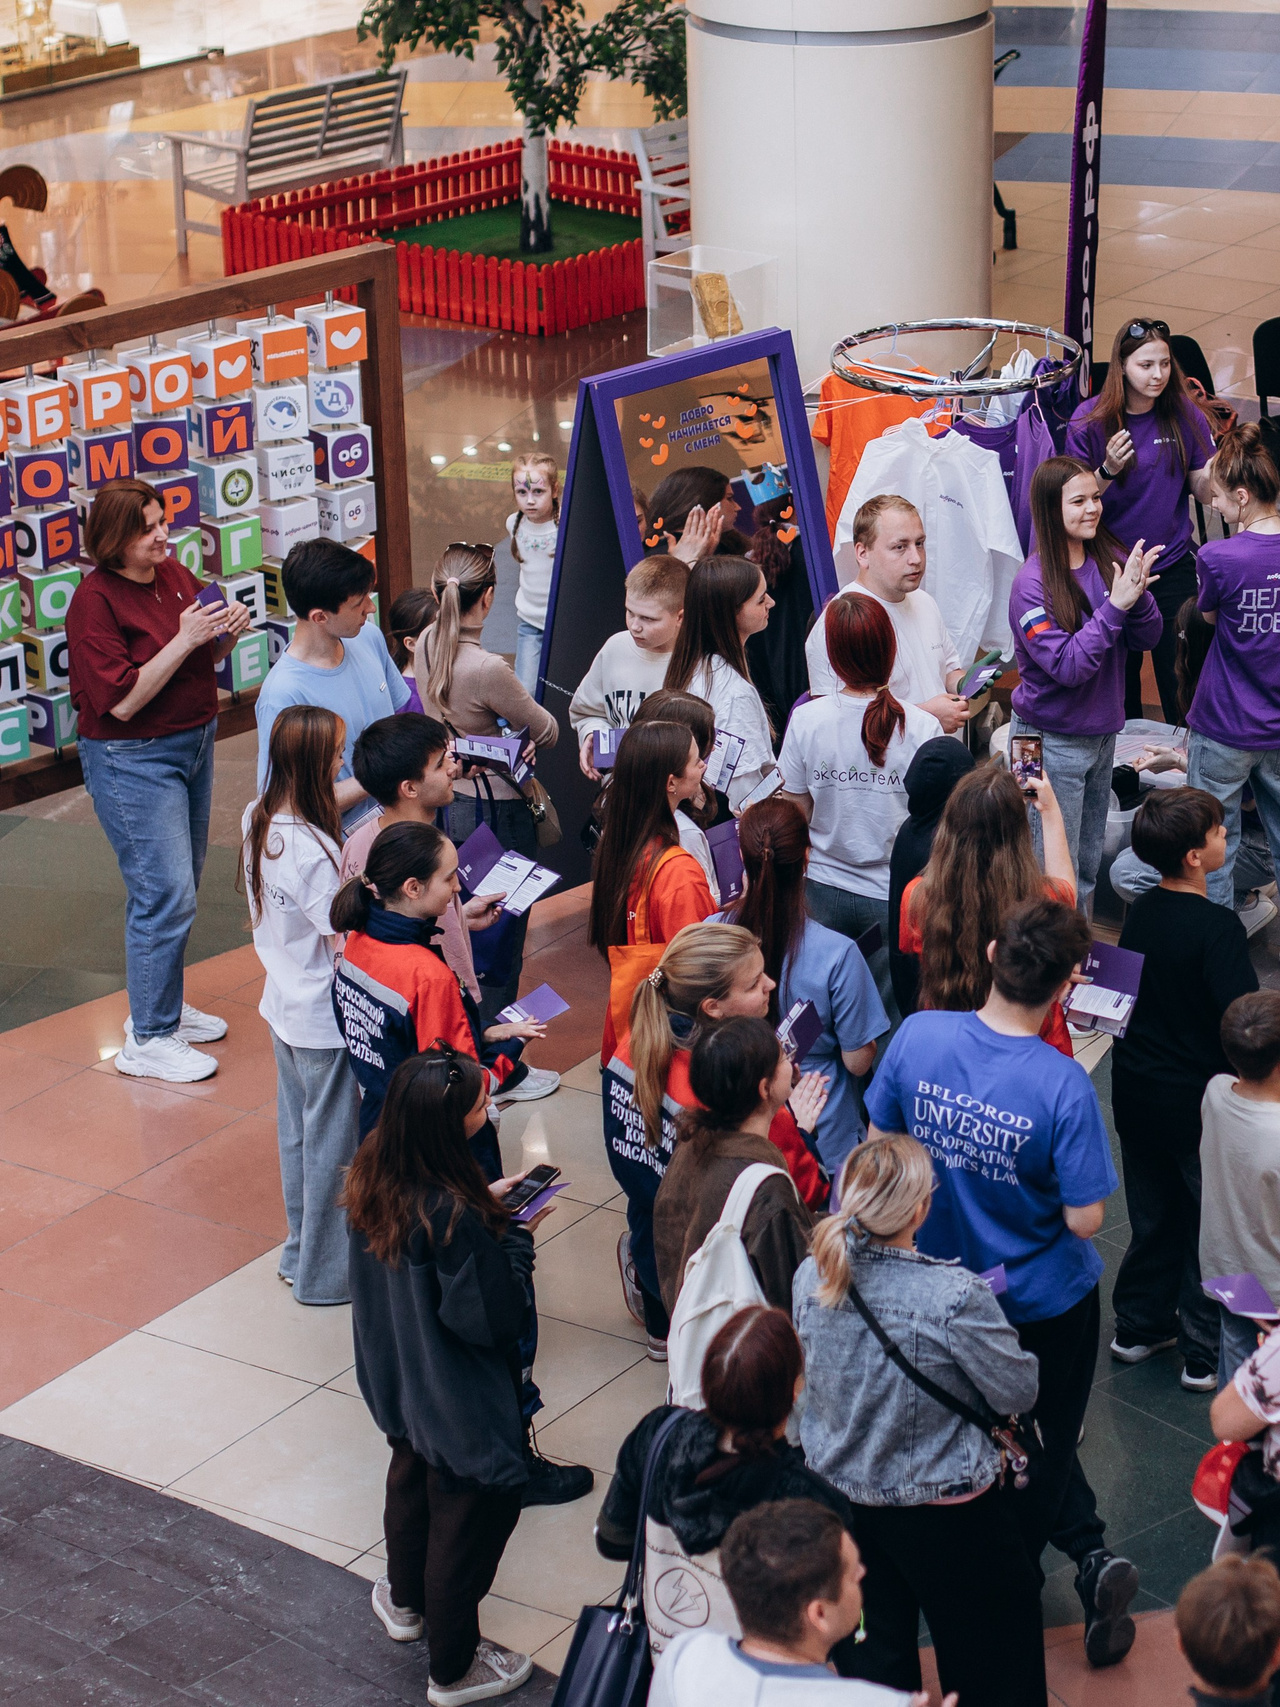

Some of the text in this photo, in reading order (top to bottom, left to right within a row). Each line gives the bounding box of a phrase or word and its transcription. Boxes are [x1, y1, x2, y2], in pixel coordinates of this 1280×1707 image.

[1078, 101, 1099, 398] бро.рф
[680, 404, 715, 426] ДОБРО
[667, 414, 732, 444] НАЧИНАЕТСЯ
[692, 433, 722, 452] МЕНЯ
[271, 463, 314, 480] ЧИСТО
[319, 510, 340, 523] СТО
[917, 1079, 1034, 1131] BELGOROD
[913, 1124, 931, 1140] OF
